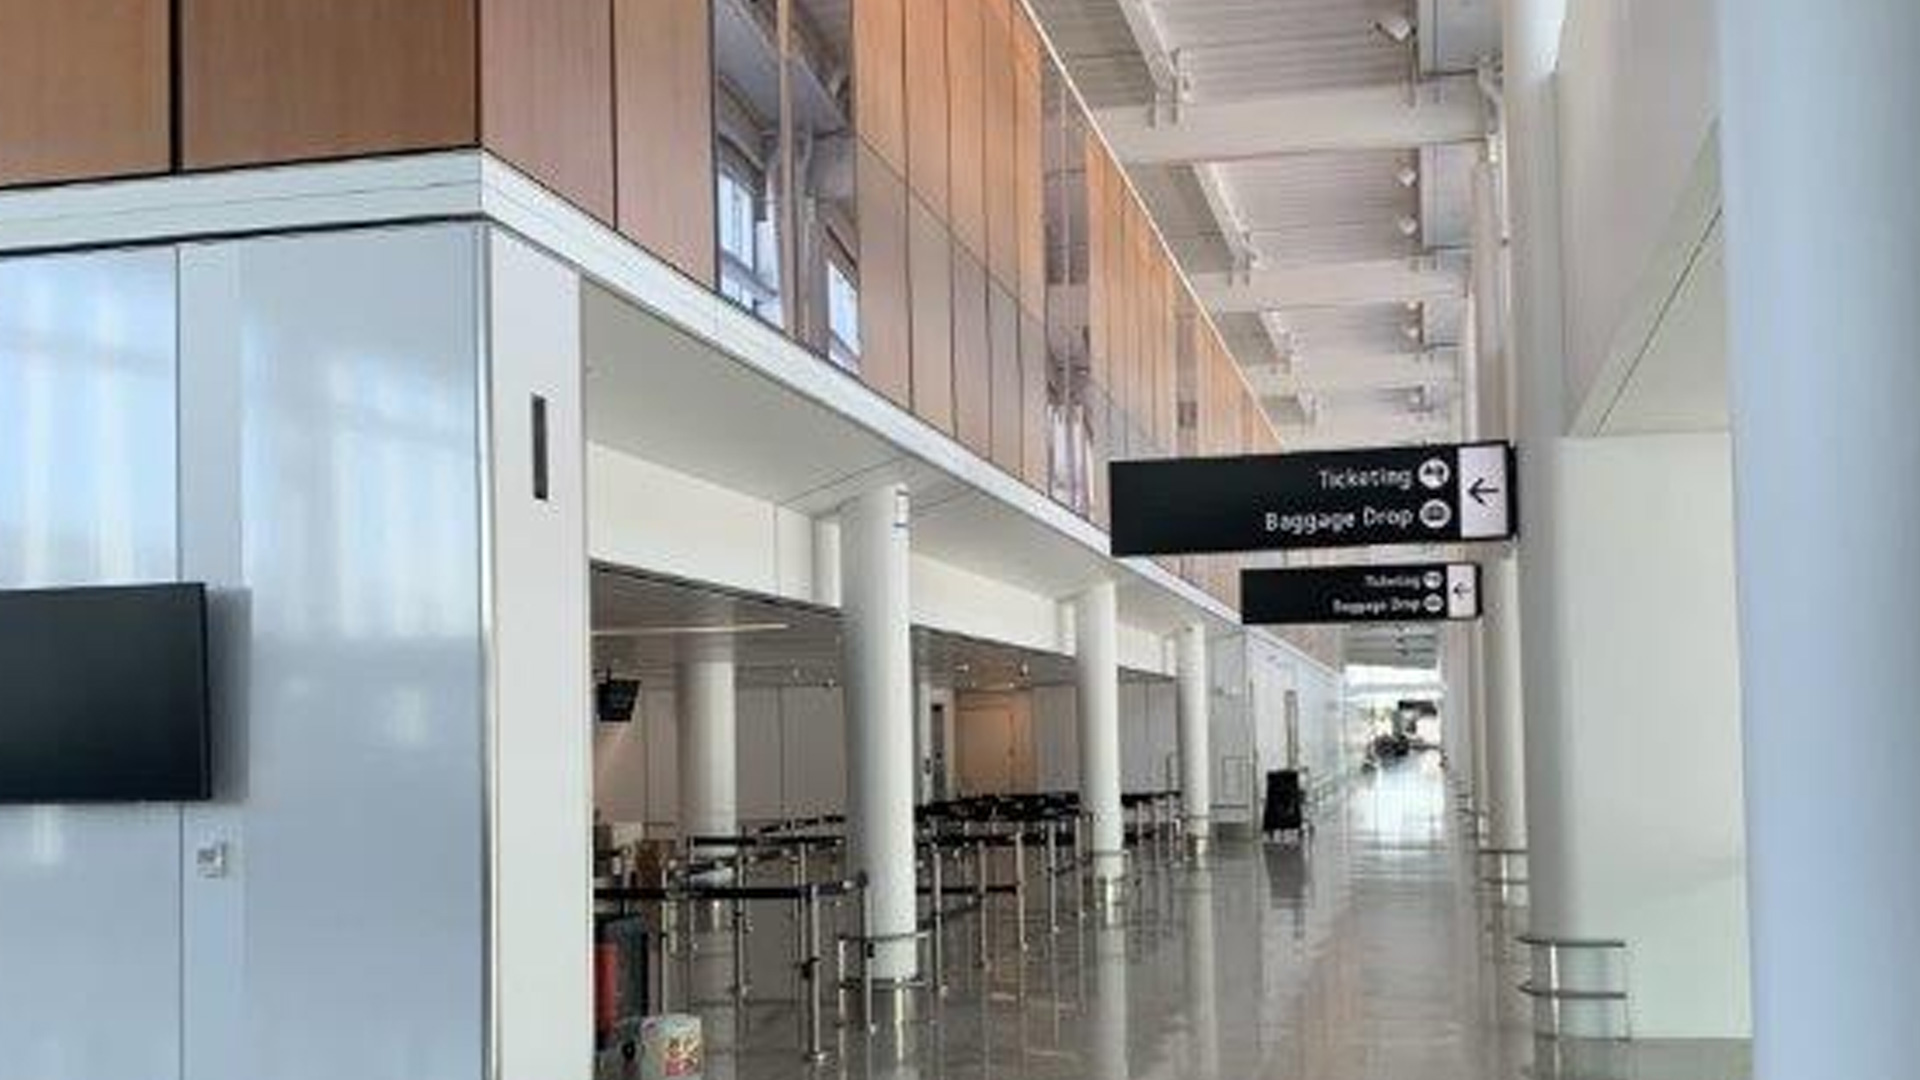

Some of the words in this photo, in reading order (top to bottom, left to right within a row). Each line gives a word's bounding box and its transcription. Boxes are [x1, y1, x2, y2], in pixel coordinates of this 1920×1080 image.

[1319, 469, 1412, 489] Ticketing
[1265, 511, 1356, 534] Baggage
[1363, 506, 1413, 528] Drop
[1365, 575, 1421, 589] Ticketing
[1334, 600, 1388, 615] Baggage
[1391, 597, 1421, 613] Drop
